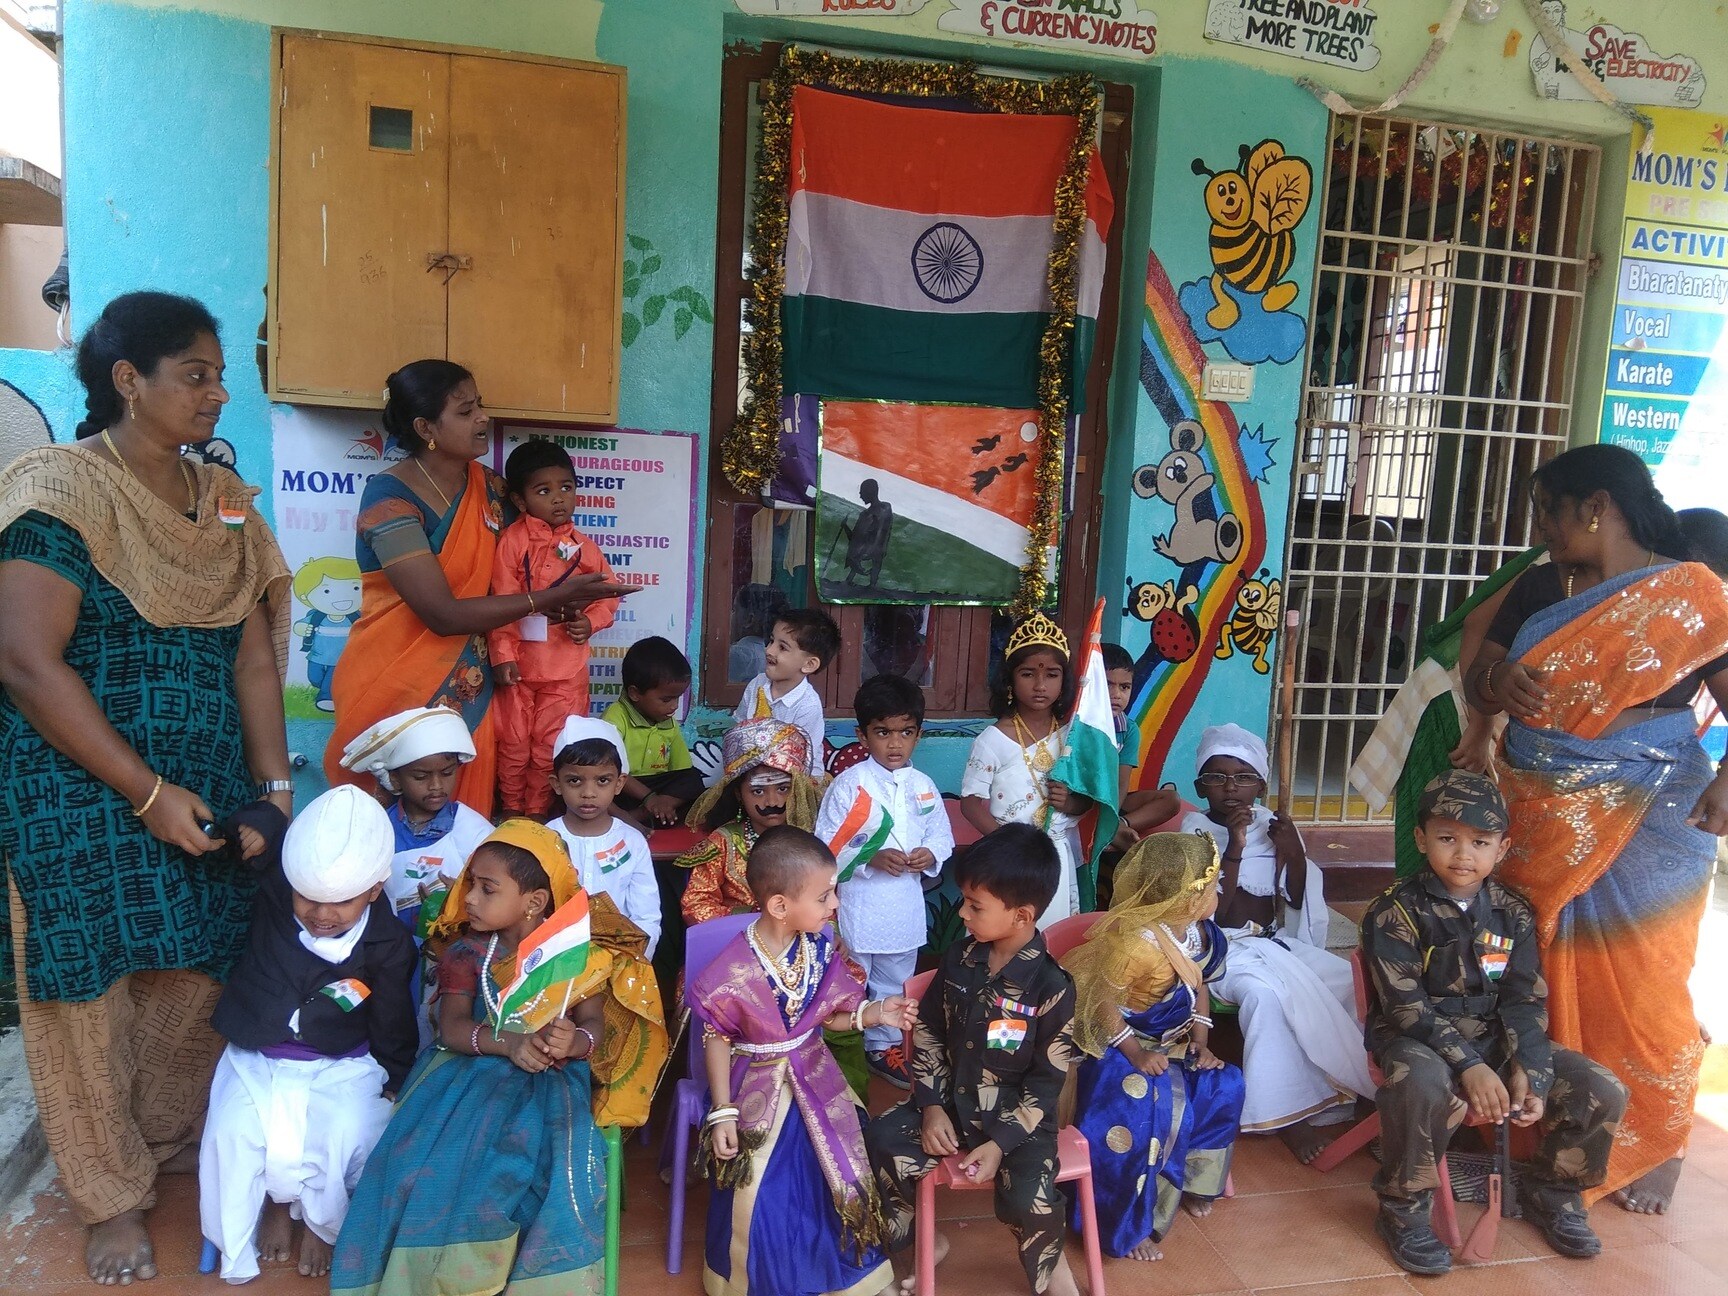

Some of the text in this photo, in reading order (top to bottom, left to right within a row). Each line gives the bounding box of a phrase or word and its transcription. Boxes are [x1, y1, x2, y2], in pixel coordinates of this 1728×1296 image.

[1245, 16, 1364, 63] MORE TREES
[1585, 26, 1637, 60] SAVE
[1631, 150, 1718, 191] MOM'S
[1631, 227, 1728, 258] ACTIVI
[1624, 309, 1671, 338] Vocal
[1617, 358, 1674, 386] Karate
[1613, 402, 1680, 430] Western
[554, 434, 619, 451] HONEST
[568, 456, 664, 473] OURAGEOUS
[281, 469, 376, 494] MOM'
[575, 475, 625, 490] SPECT
[576, 495, 616, 509] RING
[572, 513, 618, 528] TIENT
